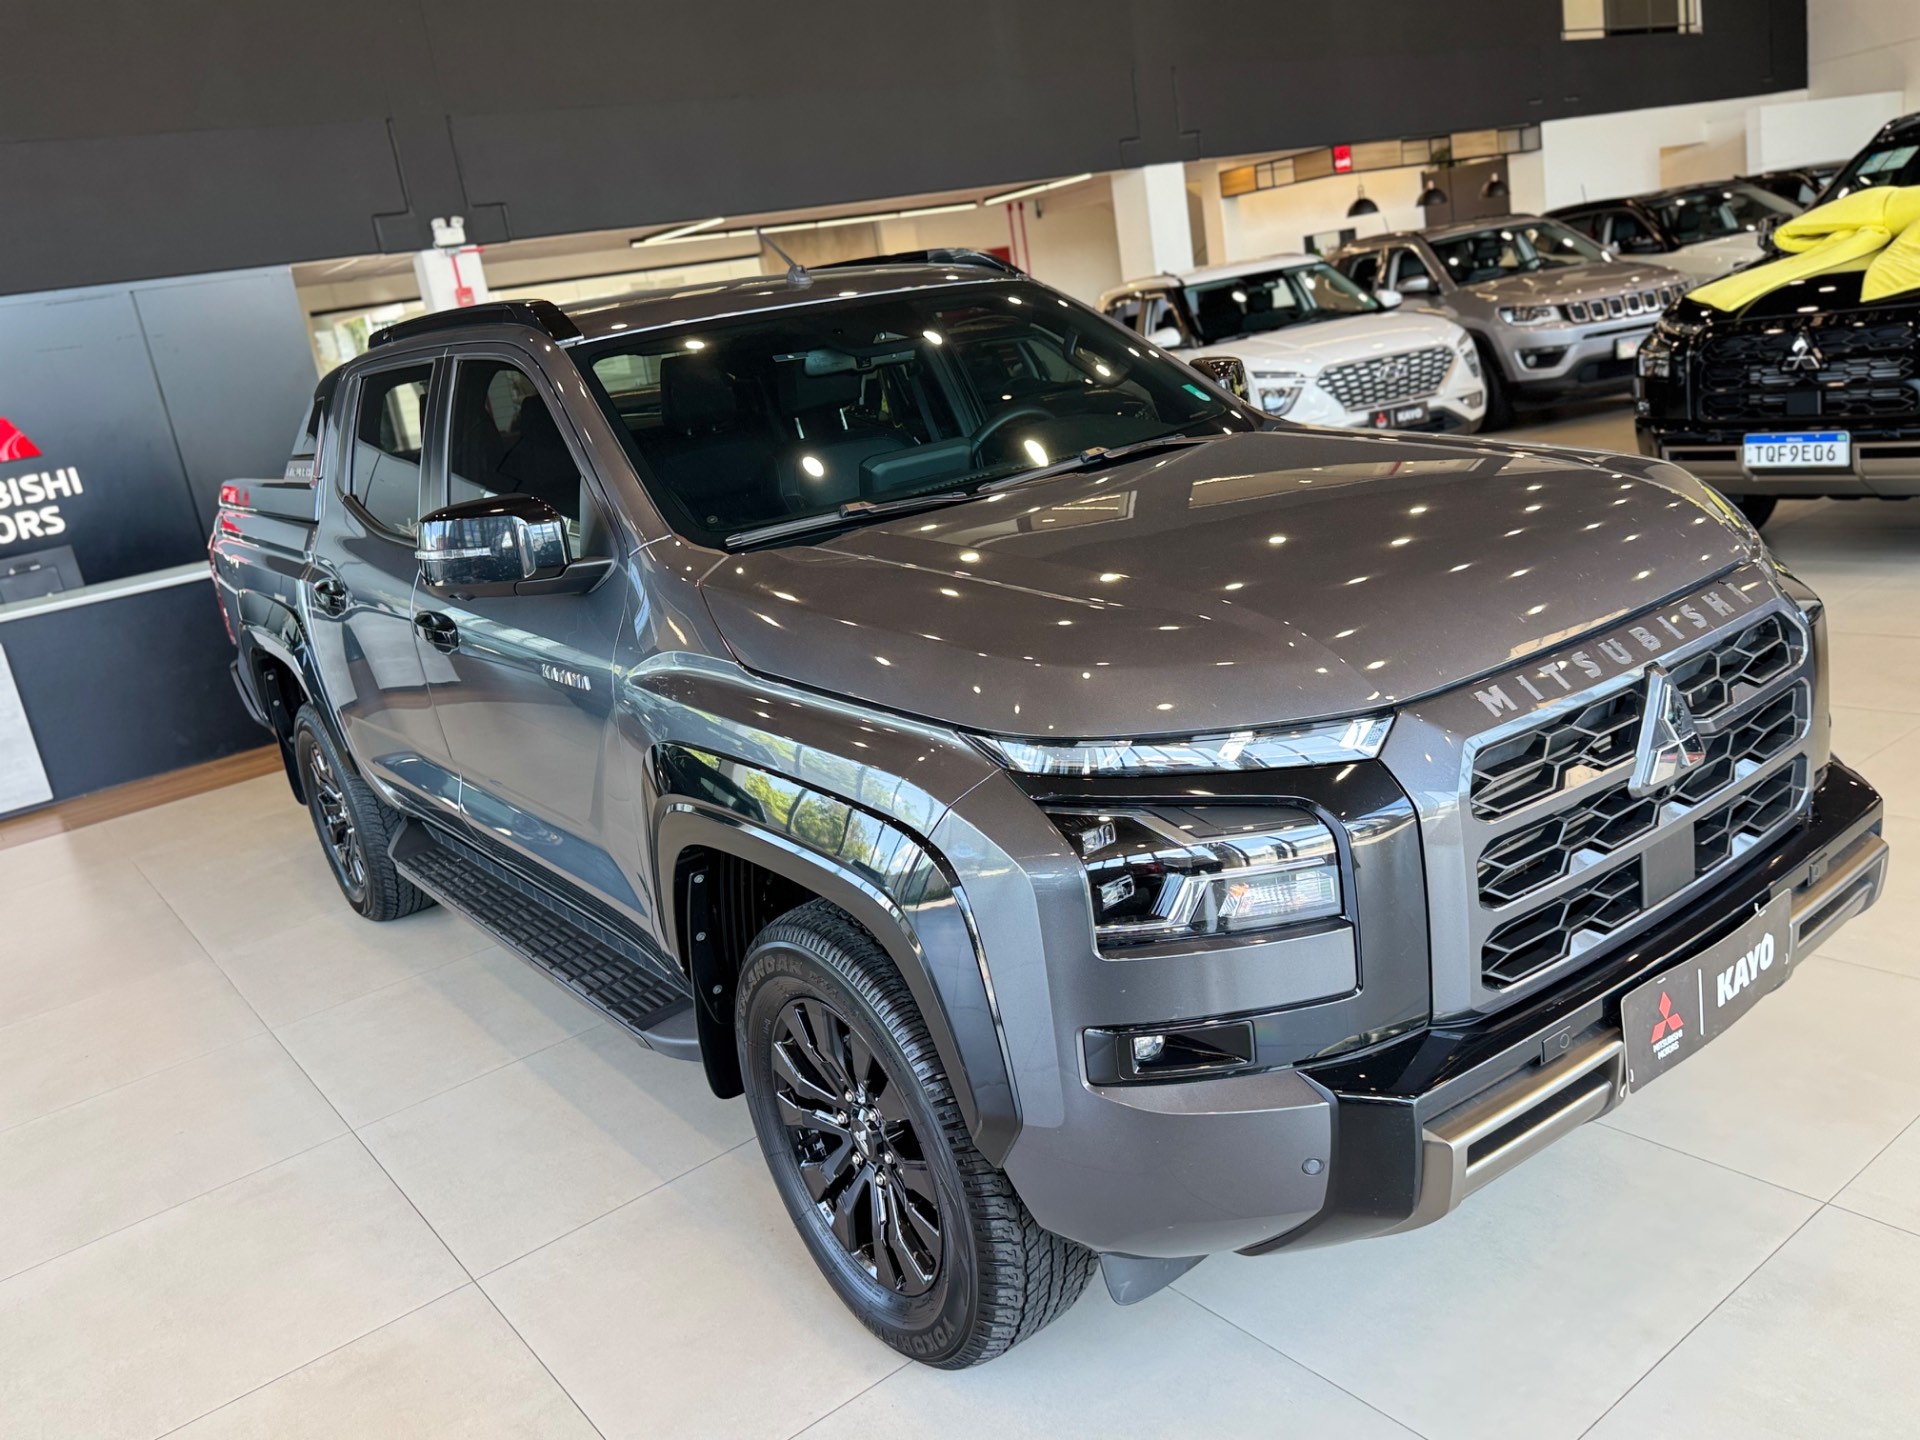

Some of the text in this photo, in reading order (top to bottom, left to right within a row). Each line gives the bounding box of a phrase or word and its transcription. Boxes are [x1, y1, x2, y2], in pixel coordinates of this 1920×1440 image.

[1754, 444, 1836, 462] TQF9E06
[0, 505, 66, 544] ORS
[1474, 582, 1752, 717] MITSUBISHI
[1716, 932, 1775, 1008] KAYO
